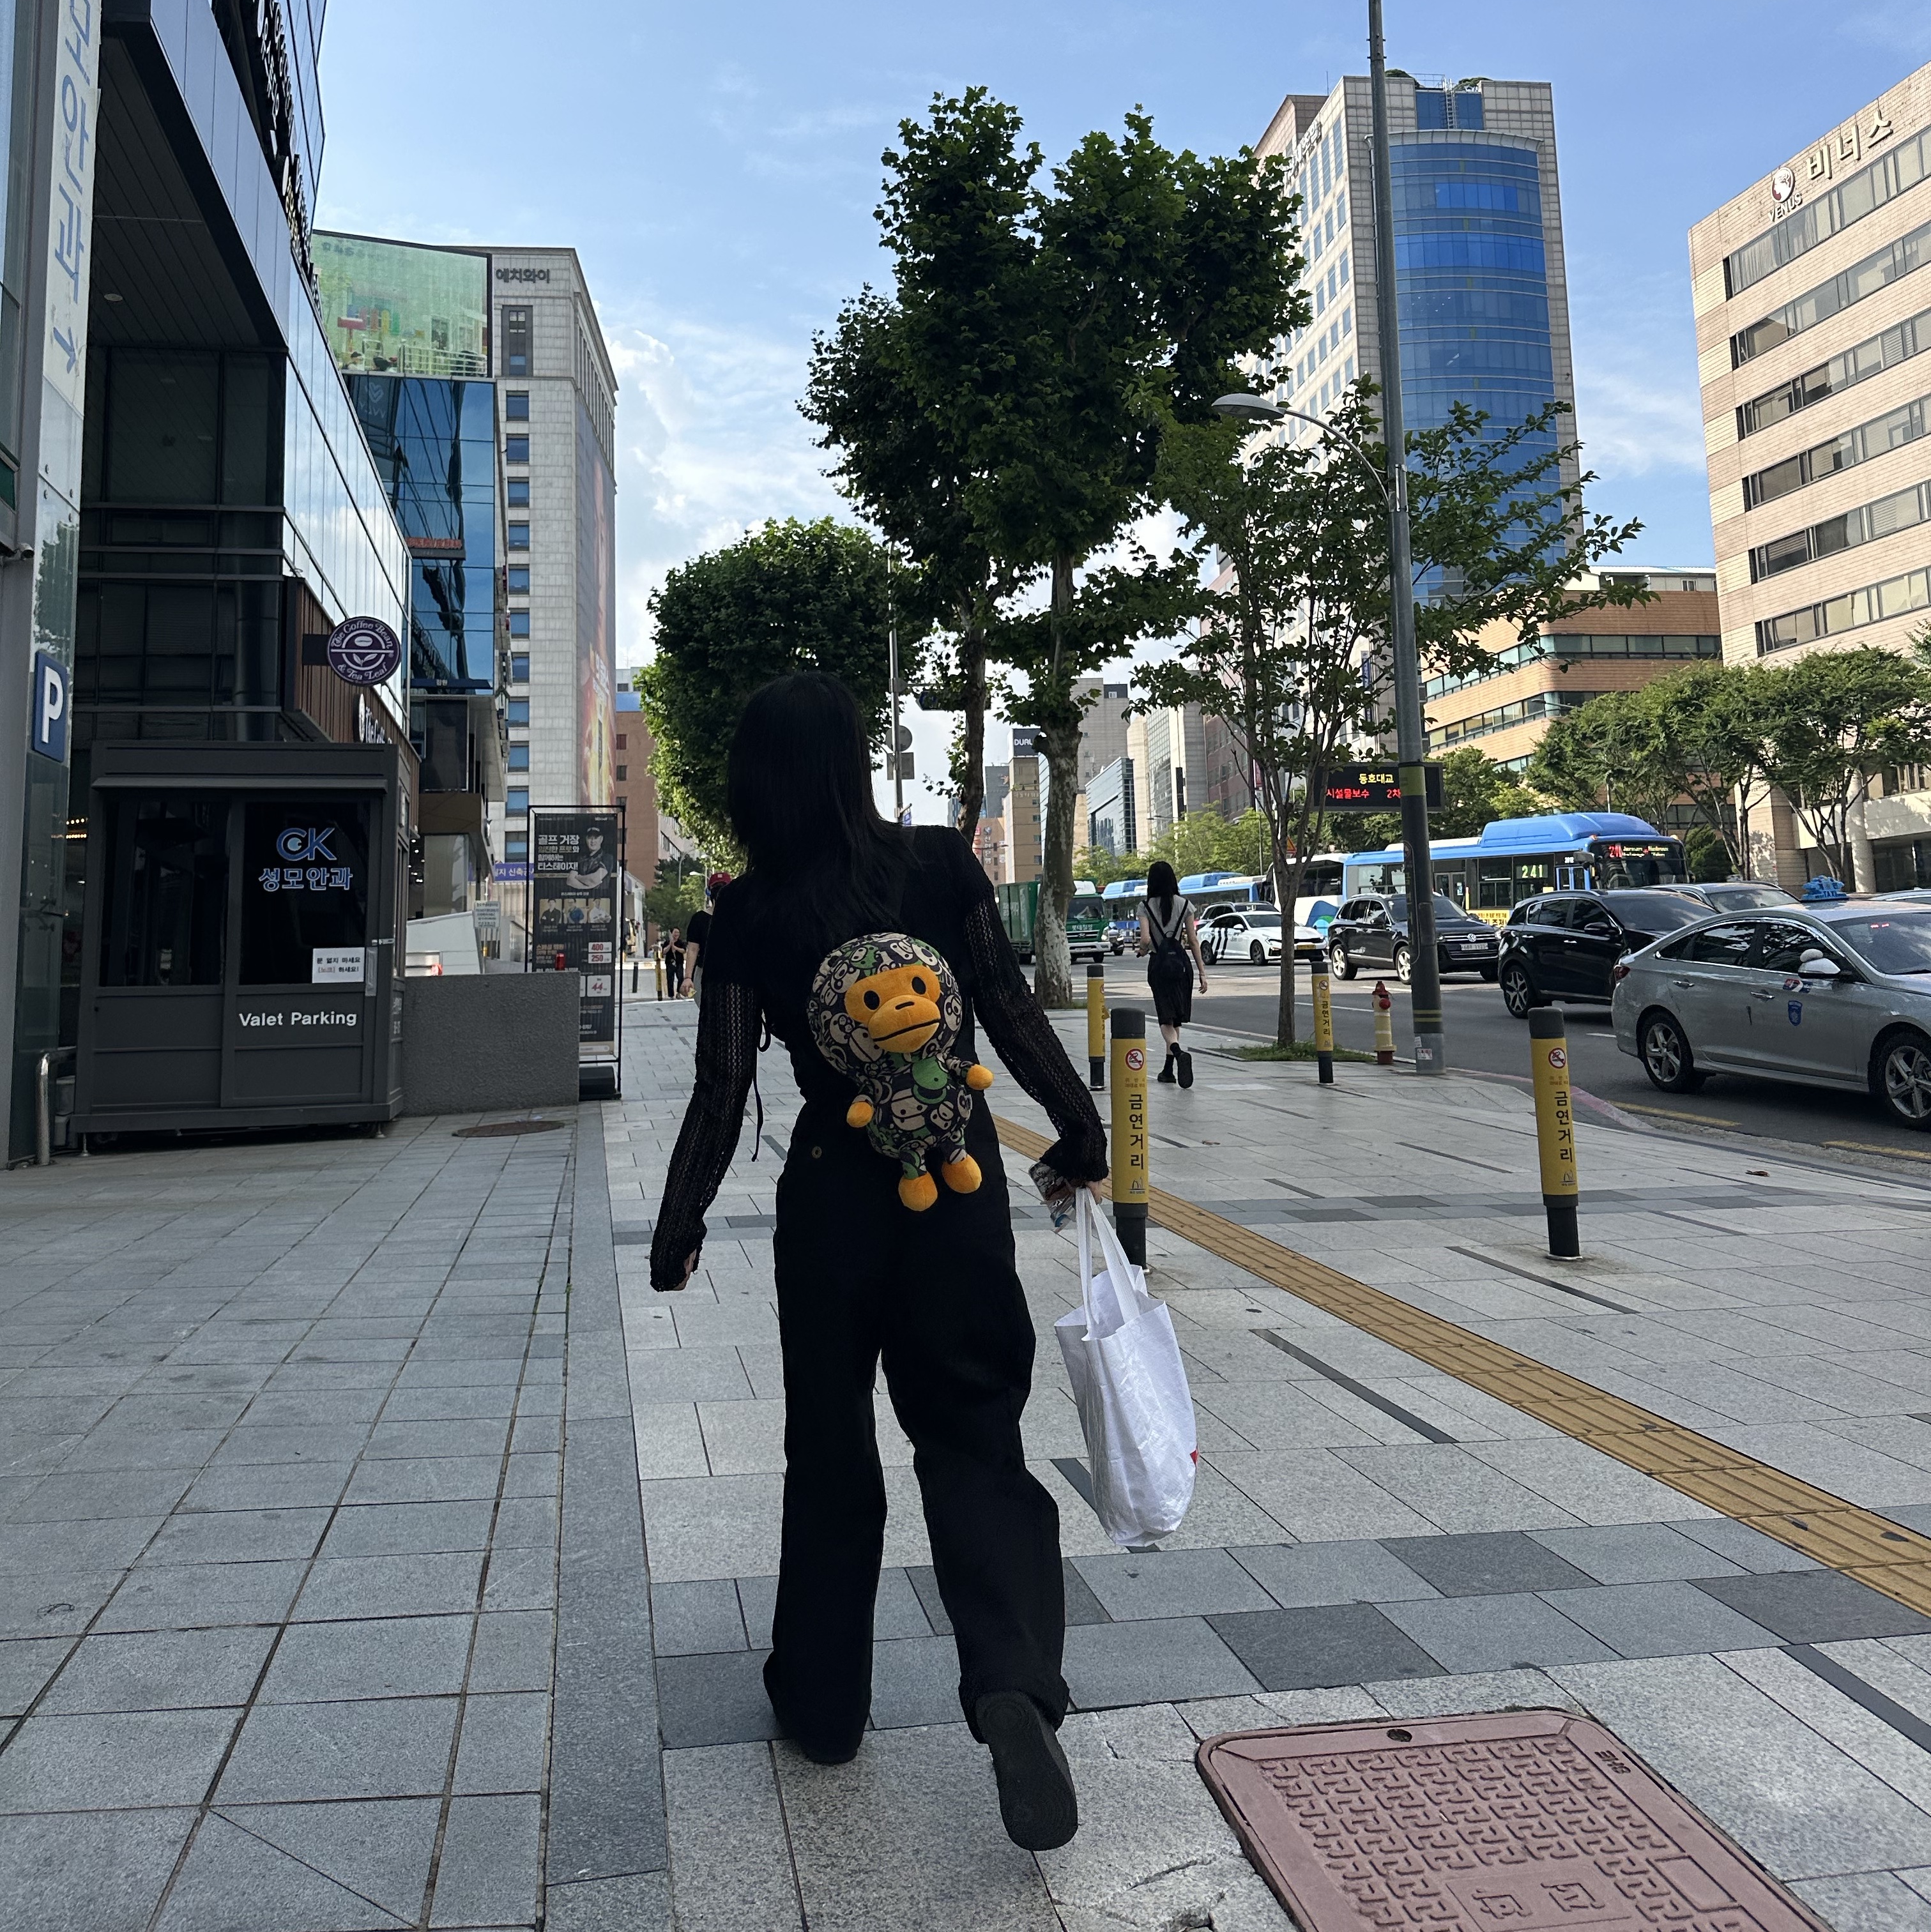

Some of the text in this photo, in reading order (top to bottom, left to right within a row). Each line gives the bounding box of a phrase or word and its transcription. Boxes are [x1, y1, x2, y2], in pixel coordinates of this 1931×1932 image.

[1806, 110, 1893, 180] 비너스
[1767, 192, 1803, 222] VENUS
[331, 620, 393, 649] The Coffee Bean
[337, 662, 387, 680] & Tea Leaf
[42, 666, 64, 743] P
[1359, 773, 1394, 784] 동호대교
[1326, 788, 1370, 798] 시설물보수
[538, 835, 580, 845] 골프 거장
[258, 867, 353, 892] 성모안과
[1522, 865, 1543, 878] 241
[592, 982, 603, 991] 44
[240, 1012, 358, 1027] Valet Parking
[1322, 1001, 1331, 1036] 금연거리
[1128, 1094, 1144, 1170] 금연거리
[1554, 1091, 1573, 1162] 금연거리
